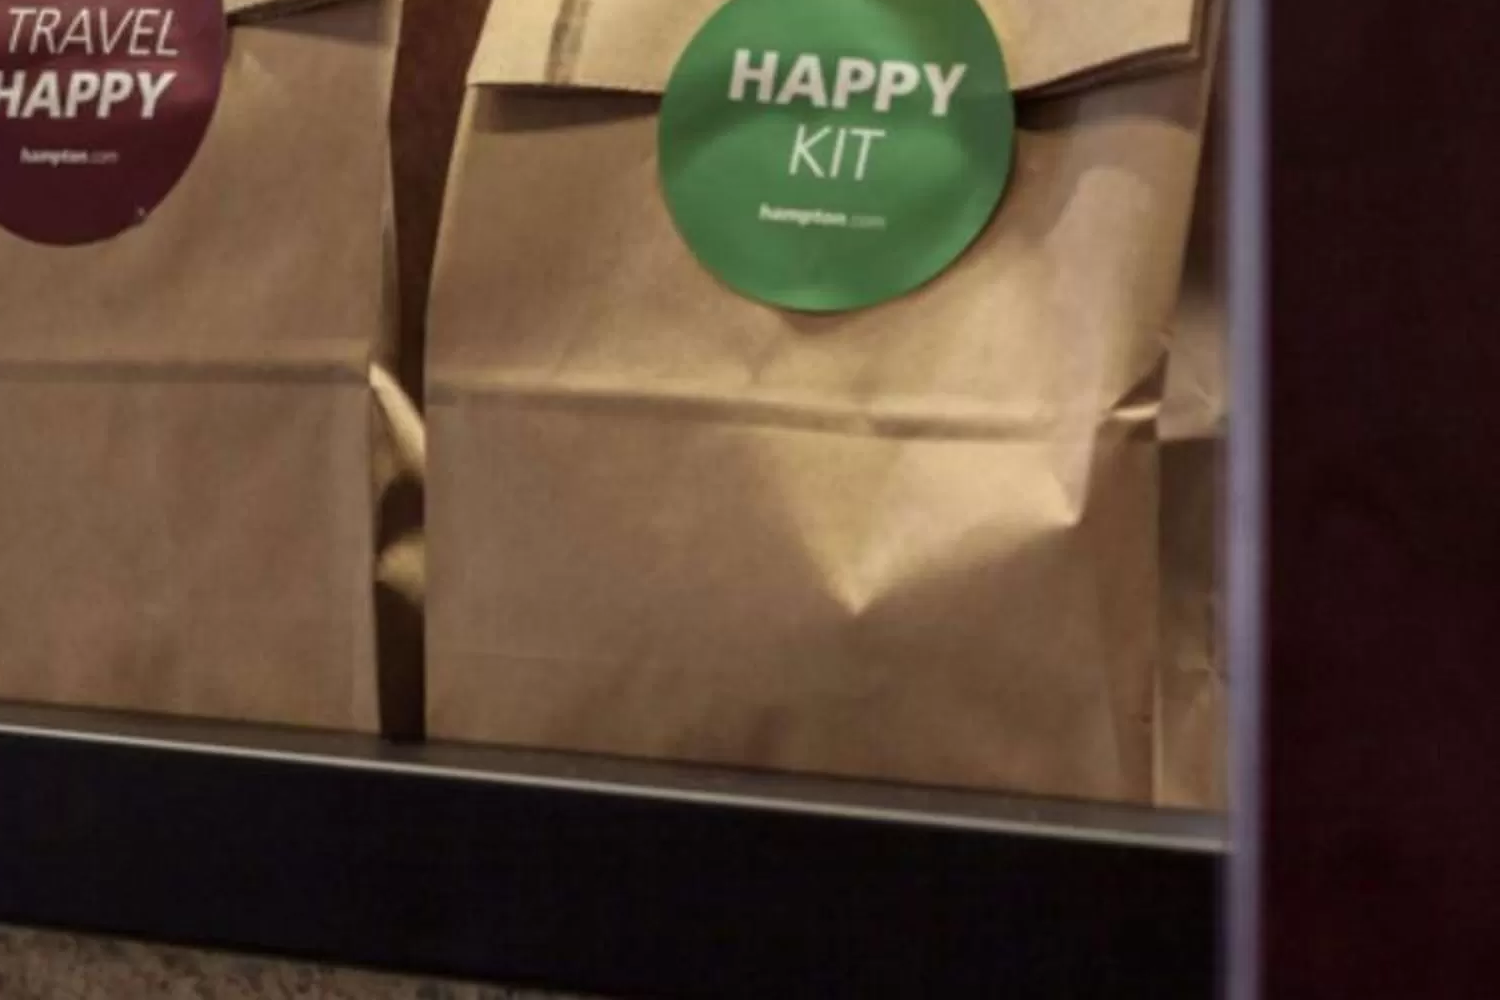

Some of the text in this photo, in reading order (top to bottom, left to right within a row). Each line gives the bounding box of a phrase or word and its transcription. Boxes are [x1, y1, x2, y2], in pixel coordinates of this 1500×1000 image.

[7, 6, 179, 56] TRAVEL
[727, 48, 967, 117] HAPPY
[788, 124, 886, 181] KIT
